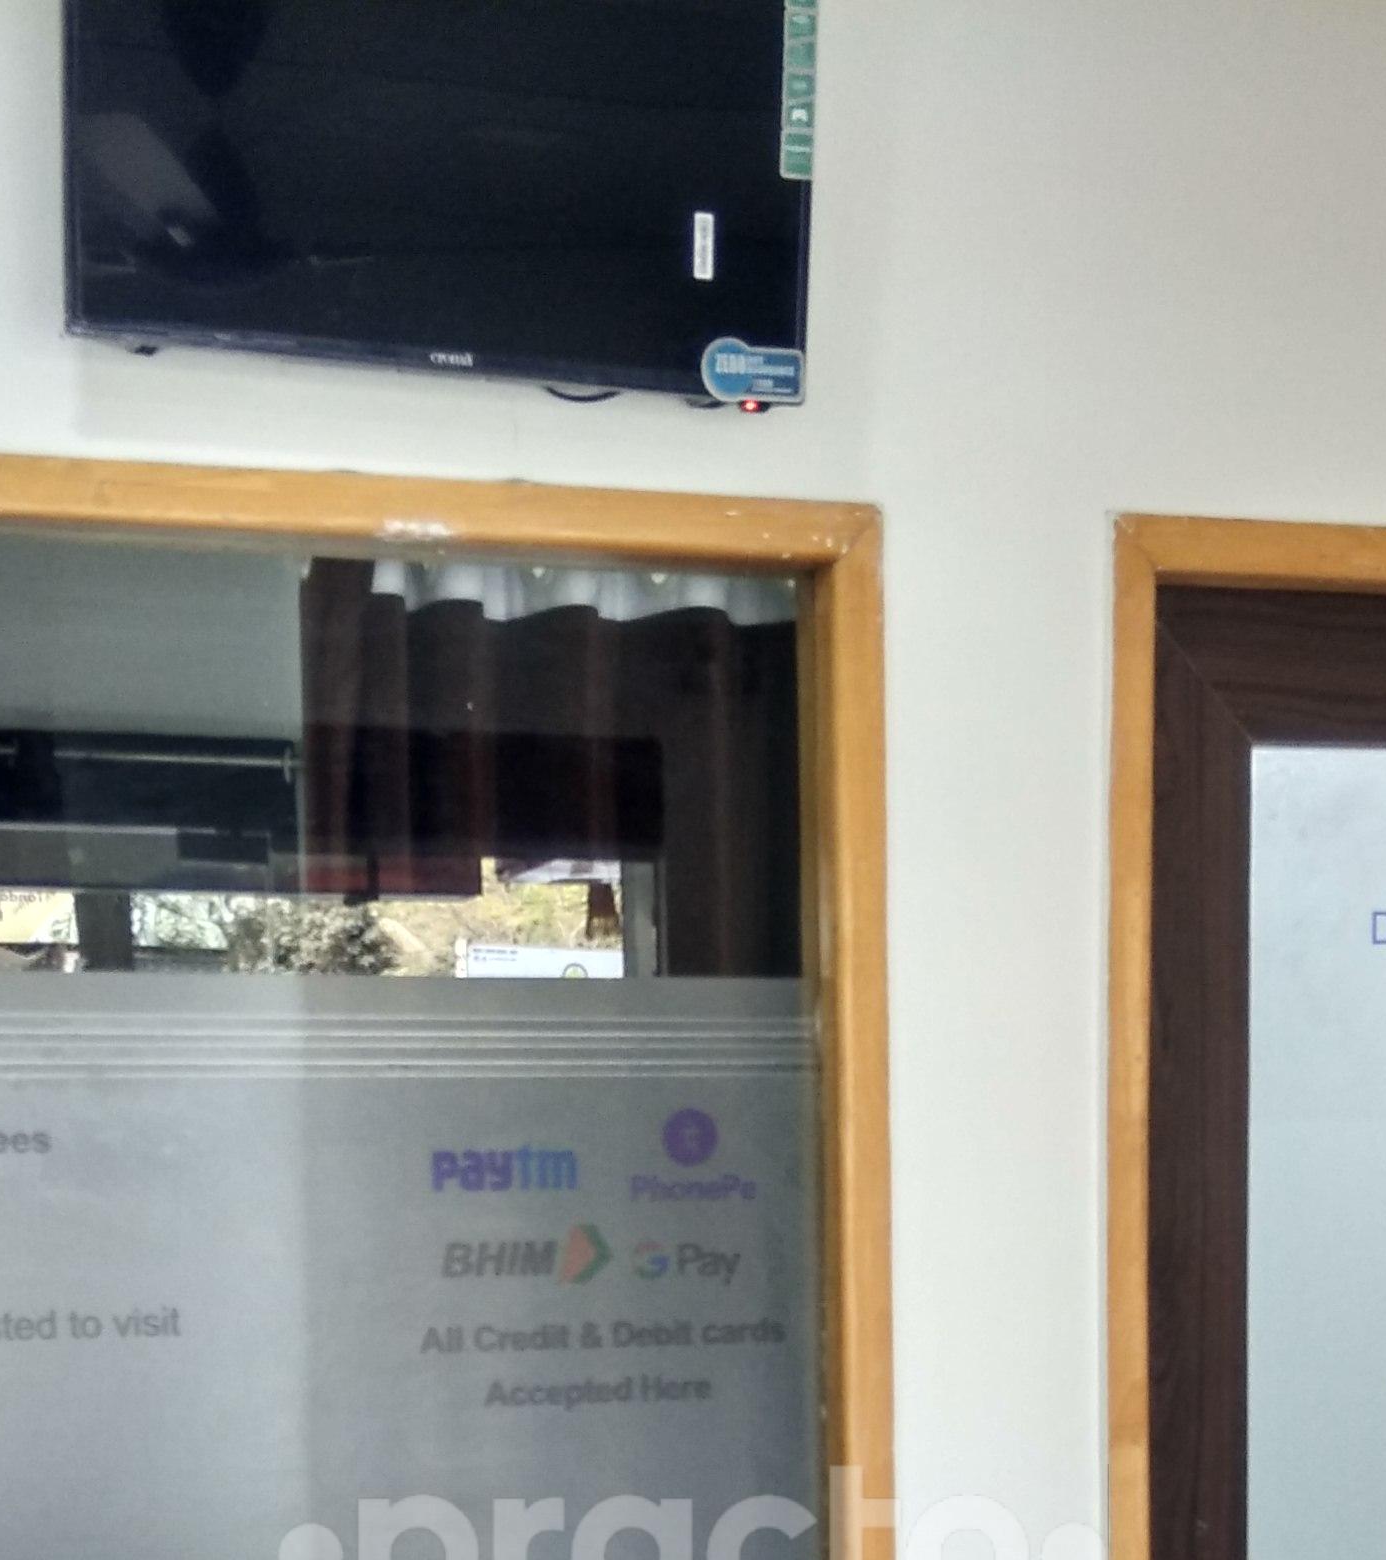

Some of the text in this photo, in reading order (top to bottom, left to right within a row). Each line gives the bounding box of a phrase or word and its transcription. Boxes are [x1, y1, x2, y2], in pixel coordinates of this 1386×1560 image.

[441, 1239, 558, 1278] BHIM
[677, 1242, 741, 1286] Pay
[70, 1310, 103, 1340] to
[112, 1305, 183, 1338] visit
[420, 1316, 789, 1355] All Credit & Debit cards
[484, 1373, 712, 1412] Accepted Here
